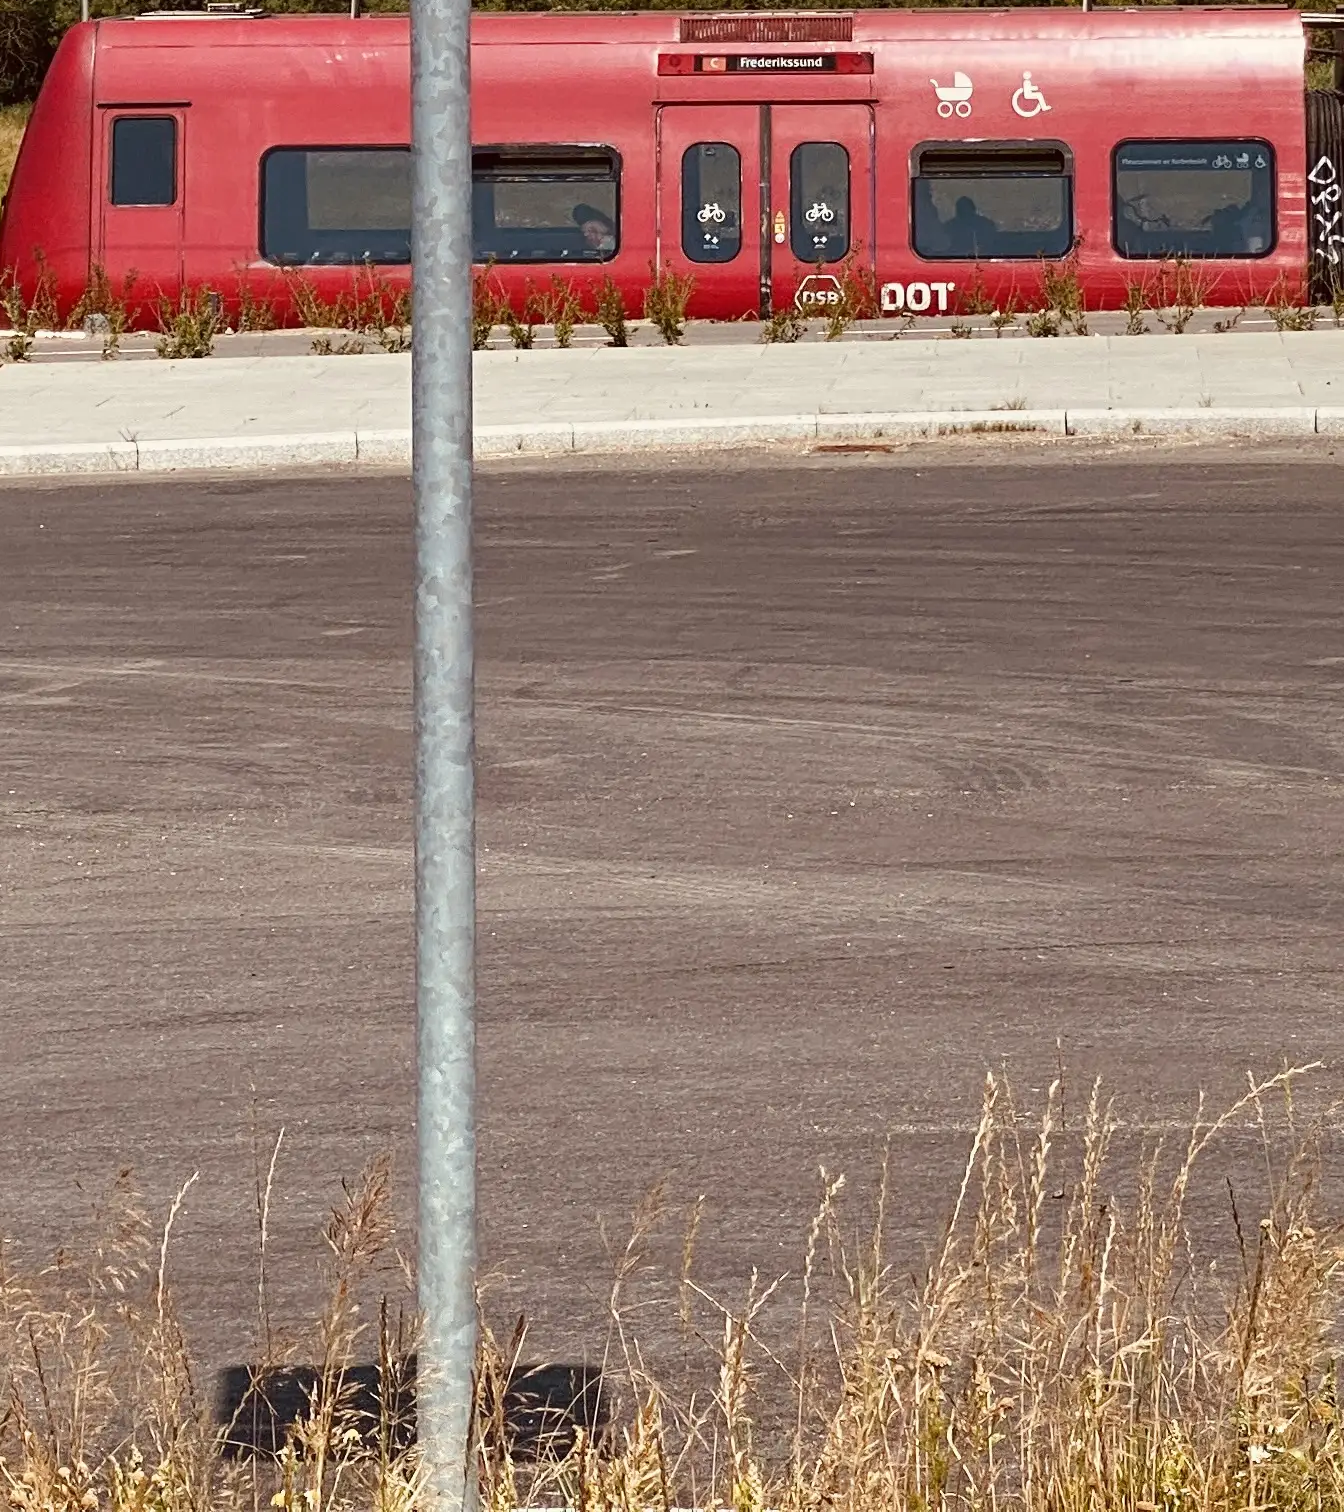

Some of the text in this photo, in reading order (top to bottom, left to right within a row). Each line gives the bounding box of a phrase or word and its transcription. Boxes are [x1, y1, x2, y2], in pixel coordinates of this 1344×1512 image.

[710, 56, 823, 68] C Frederikssund
[802, 290, 840, 305] DSB
